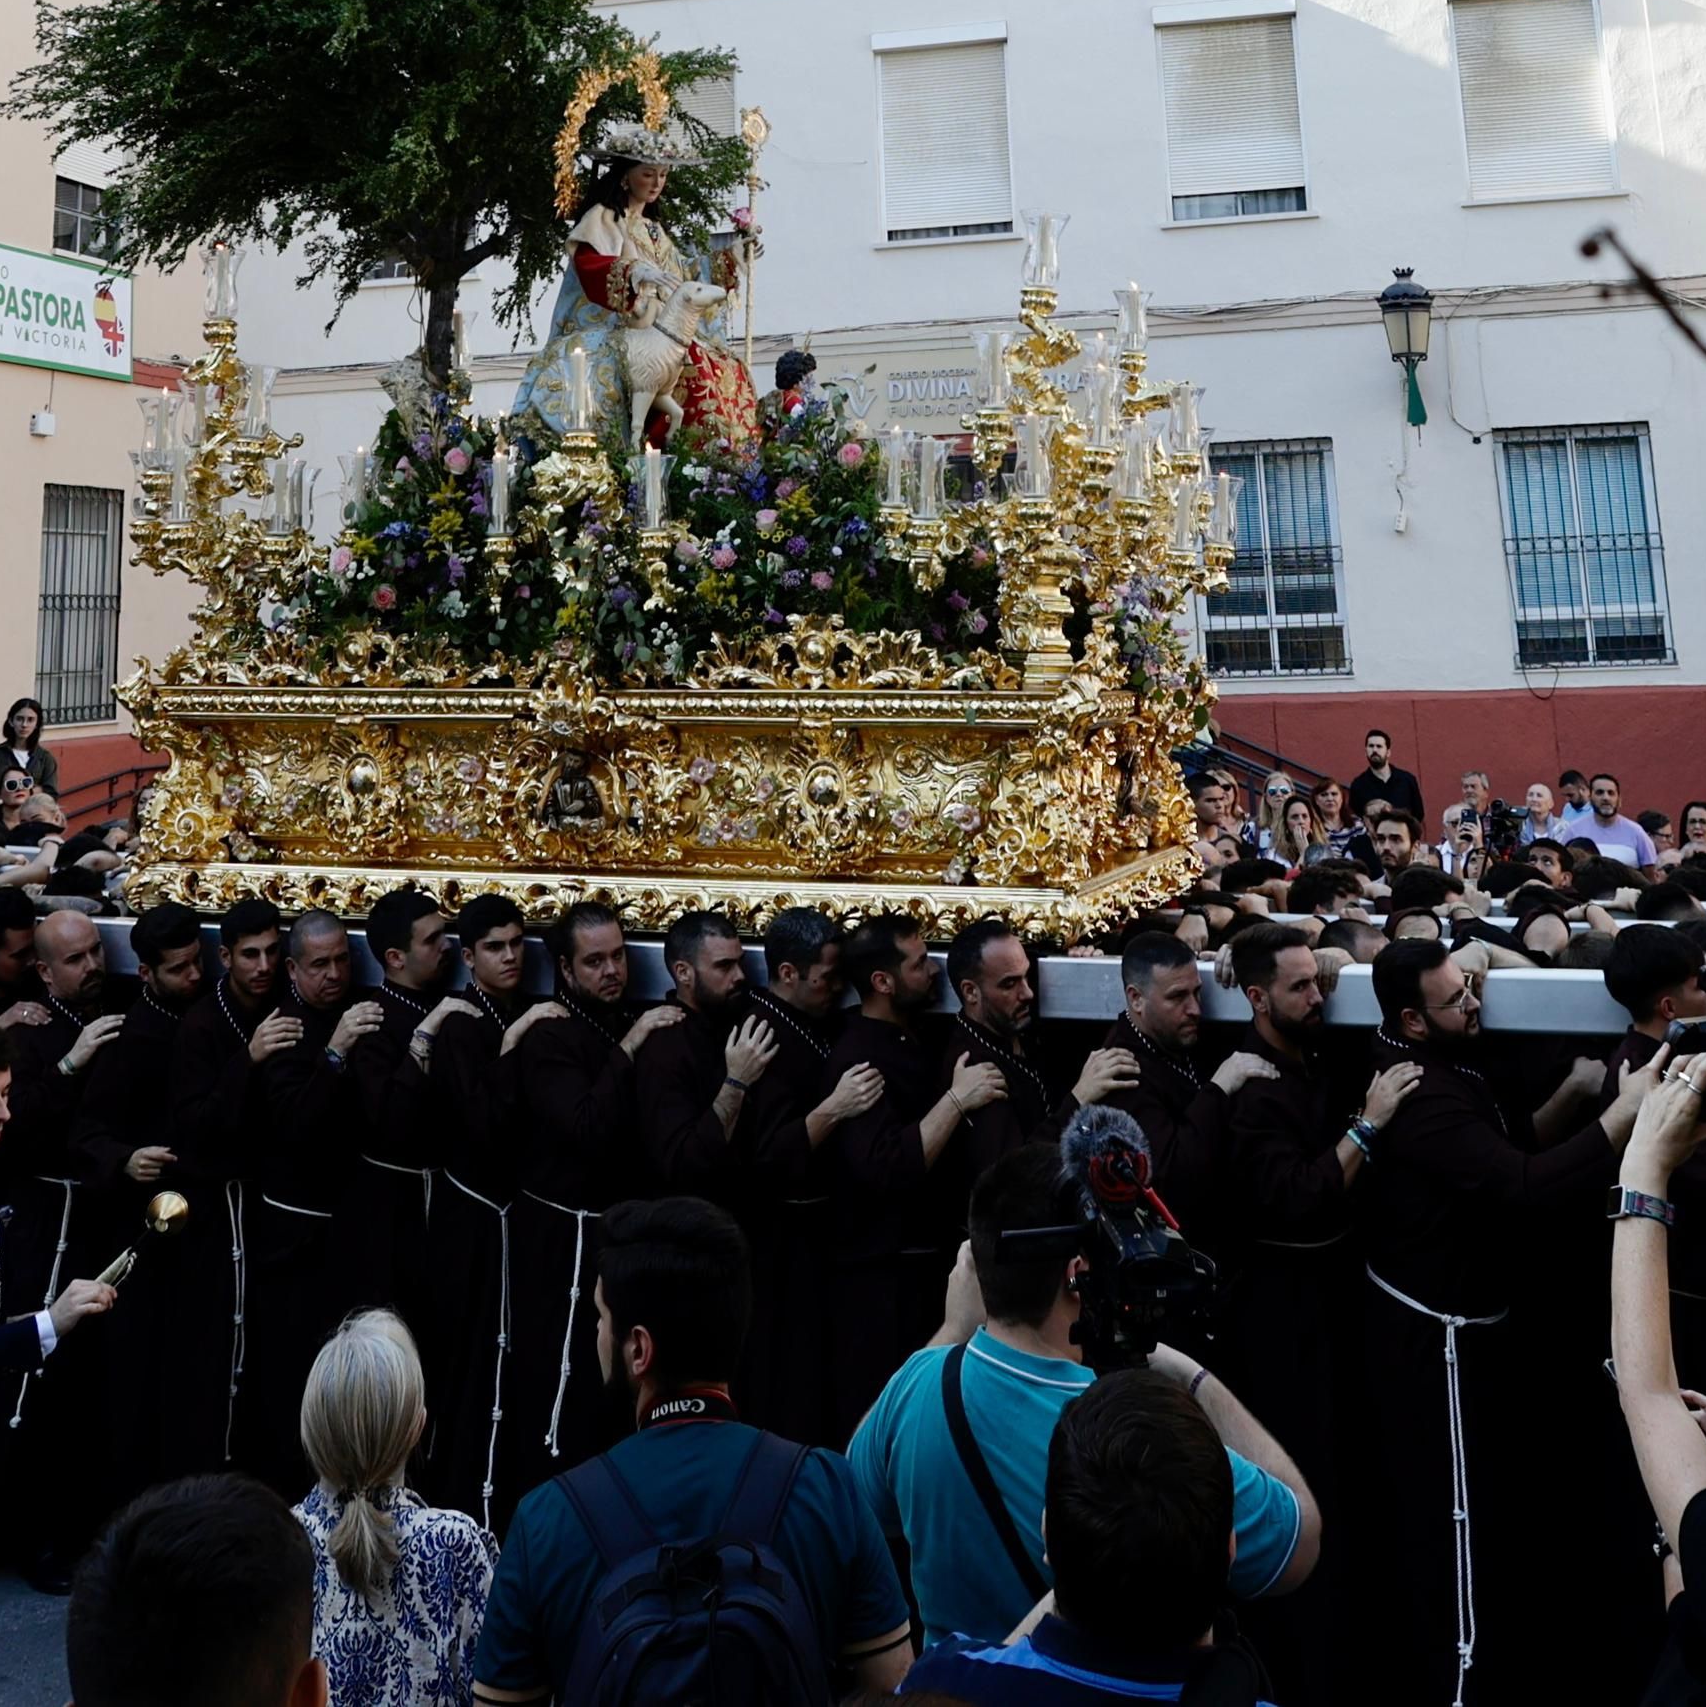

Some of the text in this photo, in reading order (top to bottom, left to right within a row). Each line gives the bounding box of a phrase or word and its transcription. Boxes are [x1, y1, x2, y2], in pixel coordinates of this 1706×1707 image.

[14, 326, 87, 352] VICTORIA
[887, 368, 977, 380] COLEGIO DIOCESAN
[887, 377, 973, 403] DIVINA
[651, 1398, 706, 1420] Canon
